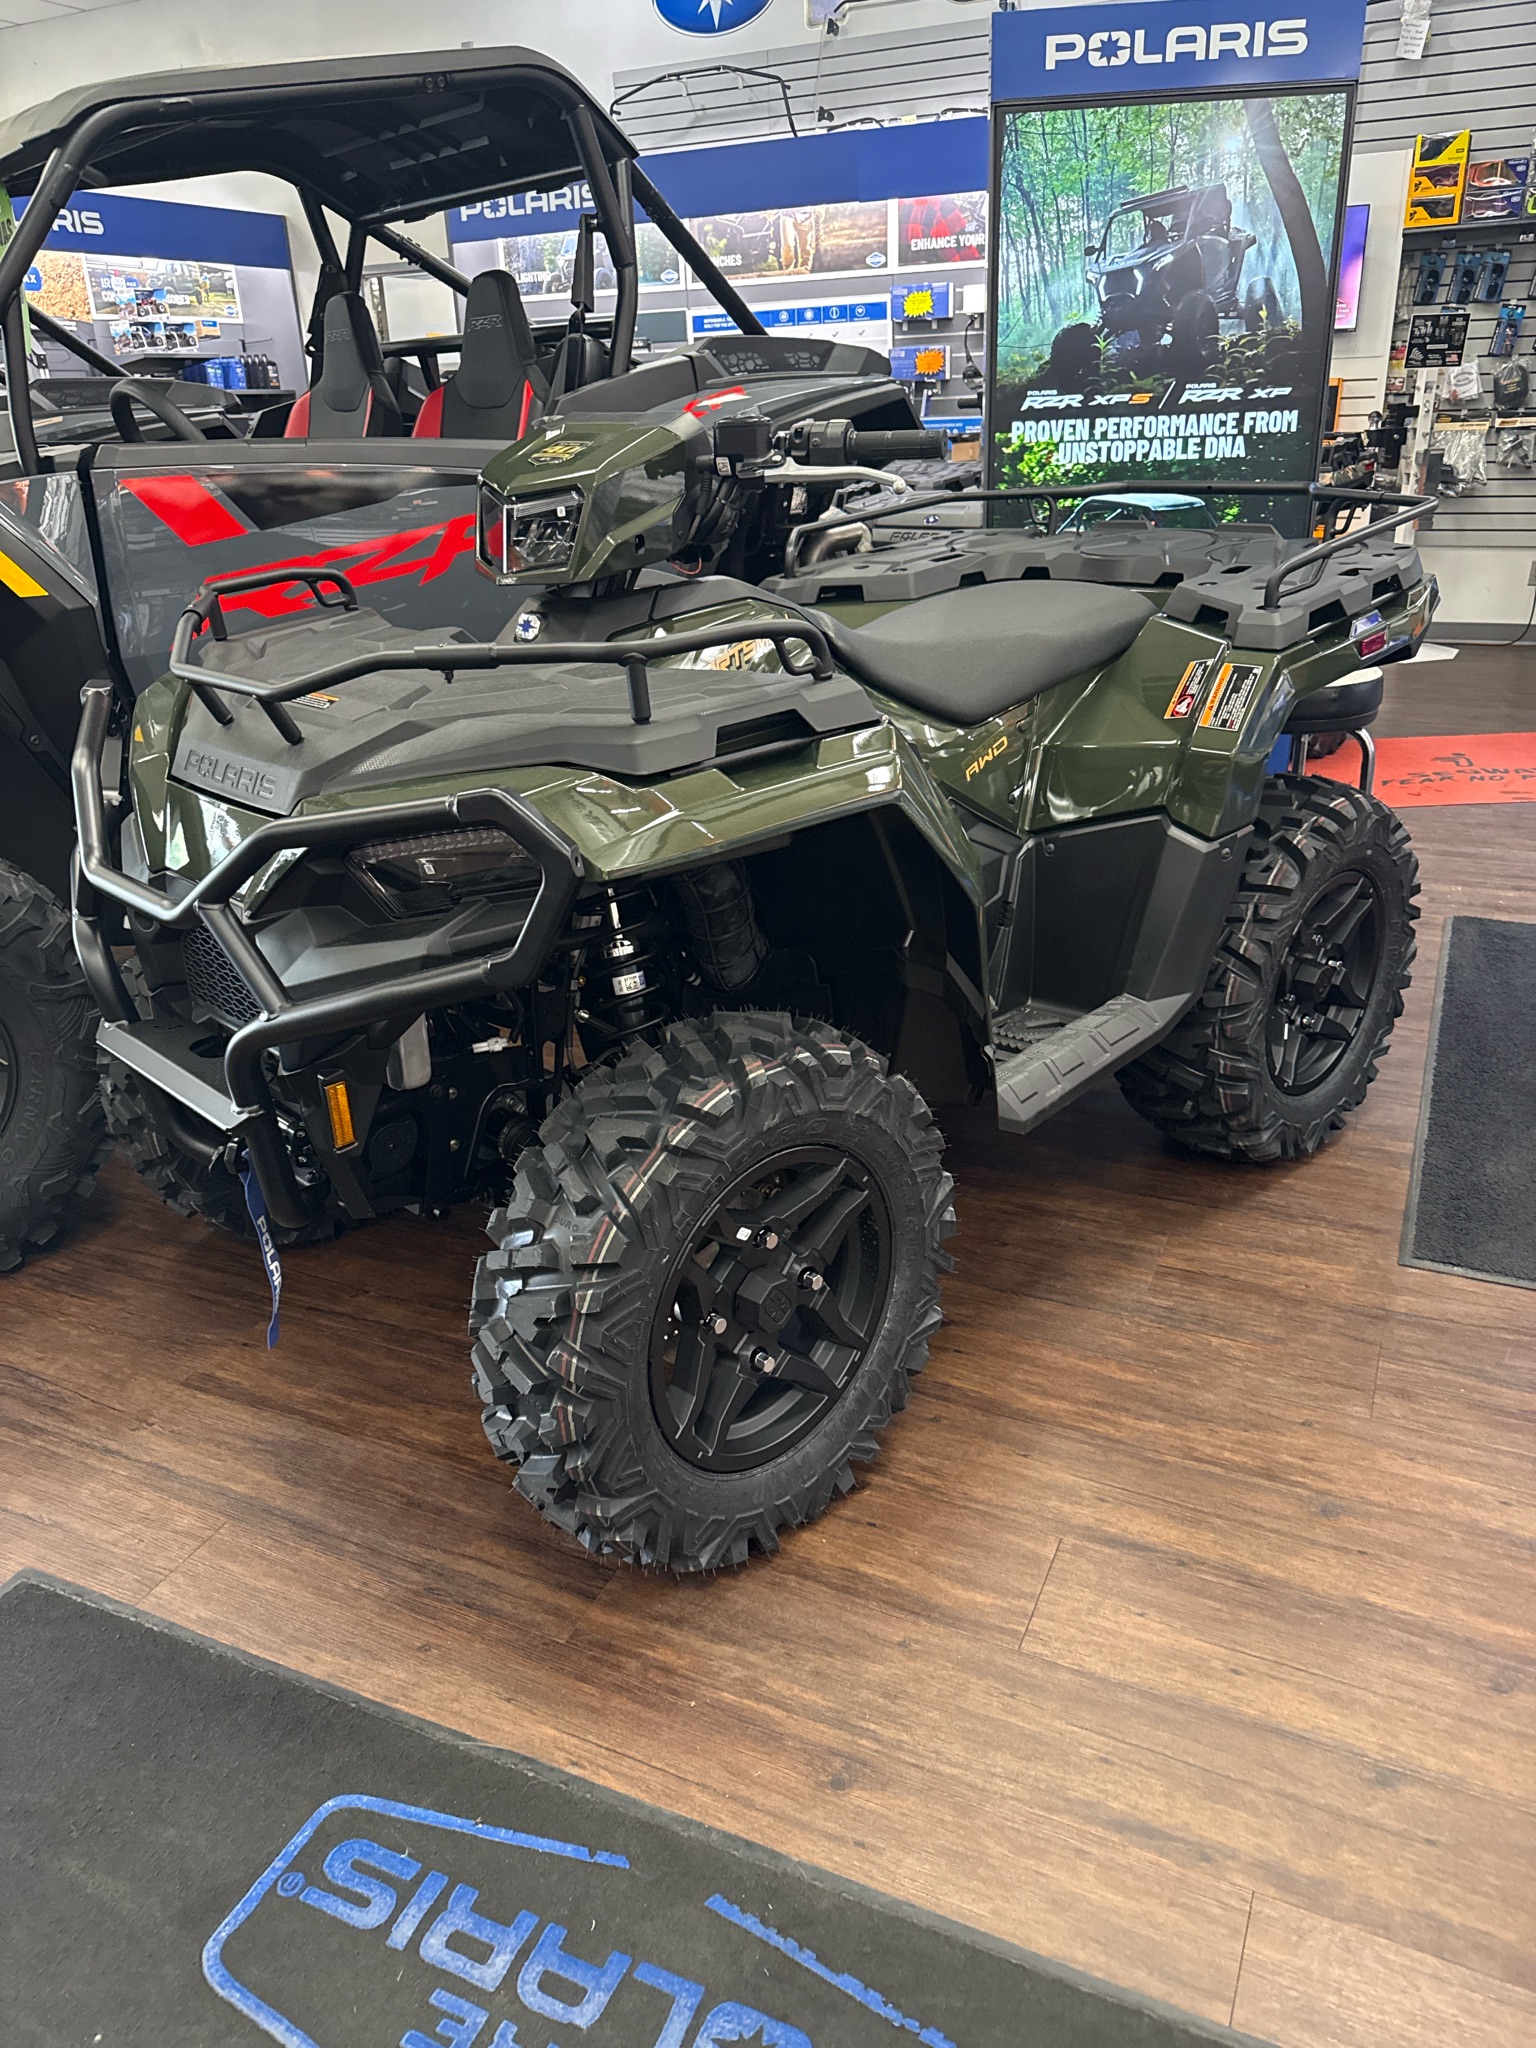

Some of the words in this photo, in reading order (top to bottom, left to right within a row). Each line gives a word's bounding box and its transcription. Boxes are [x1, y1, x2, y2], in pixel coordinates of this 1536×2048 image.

[1044, 19, 1309, 70] POLARIS
[460, 183, 596, 222] POLARIS
[52, 208, 105, 235] RIS
[911, 235, 958, 251] ENHANCE
[958, 232, 986, 247] YOUR
[710, 253, 743, 267] NCHES
[515, 270, 552, 284] LIGHTING
[467, 313, 504, 333] RZR
[1026, 389, 1058, 397] POLARIS
[1178, 387, 1244, 405] RZR
[1248, 386, 1293, 400] XP
[1186, 382, 1217, 390] POLARIS
[1020, 394, 1085, 412] RZR
[1011, 418, 1090, 443] PROVEN
[1094, 412, 1239, 441] PERFORMANCE
[1243, 409, 1299, 435] FROM
[1058, 437, 1202, 465] UNSTOPPABLE
[1204, 435, 1246, 460] DNA
[1210, 677, 1225, 706] WARNING
[965, 735, 1008, 782] AWD
[184, 749, 278, 800] POLARIS
[553, 1213, 580, 1233] DURO
